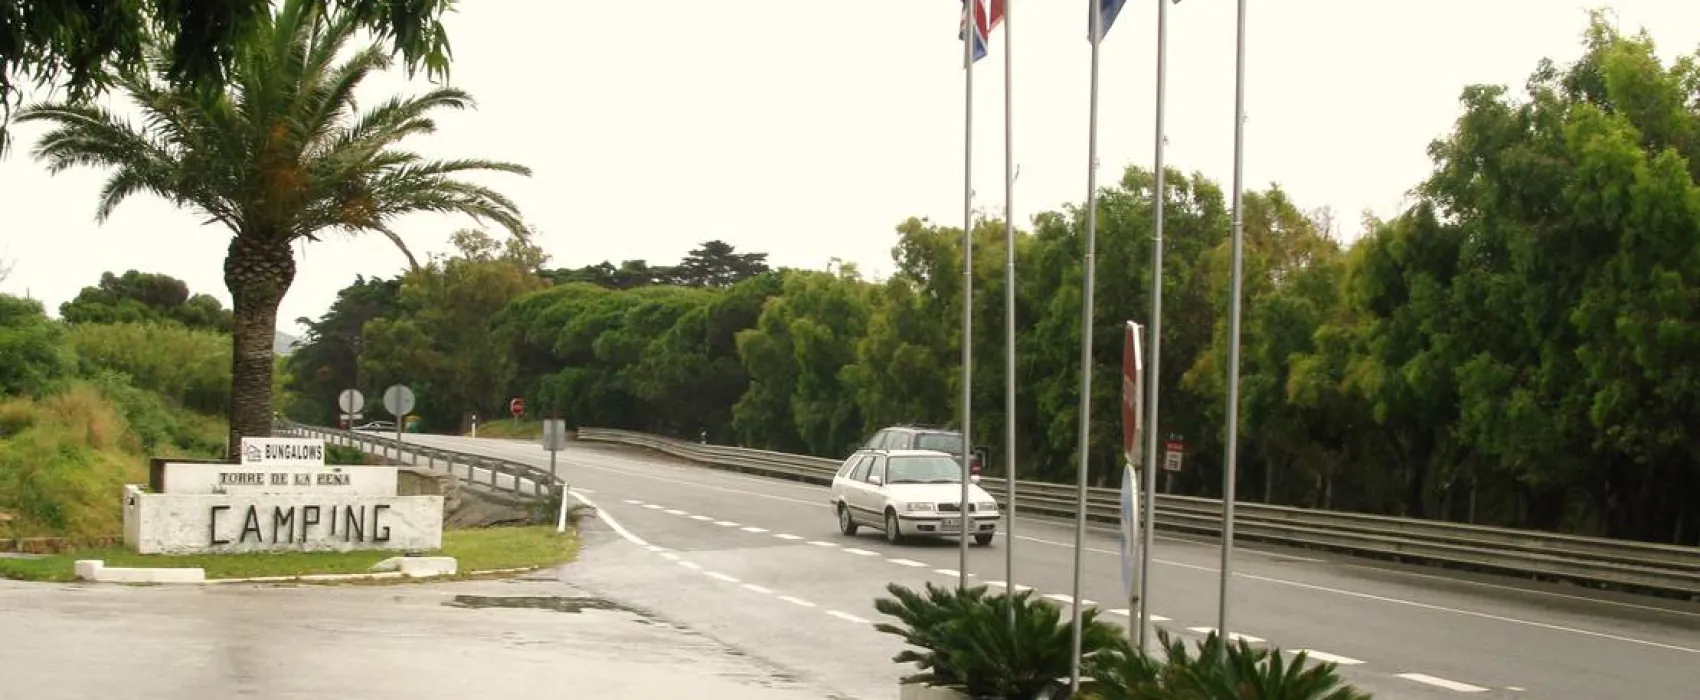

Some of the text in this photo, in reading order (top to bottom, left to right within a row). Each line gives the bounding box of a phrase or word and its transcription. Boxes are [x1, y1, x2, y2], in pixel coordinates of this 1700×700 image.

[265, 444, 322, 460] BUNGALOWS
[219, 472, 264, 485] TORRE
[270, 472, 288, 485] DE
[294, 472, 311, 485] LA
[210, 504, 391, 545] CAMPING
